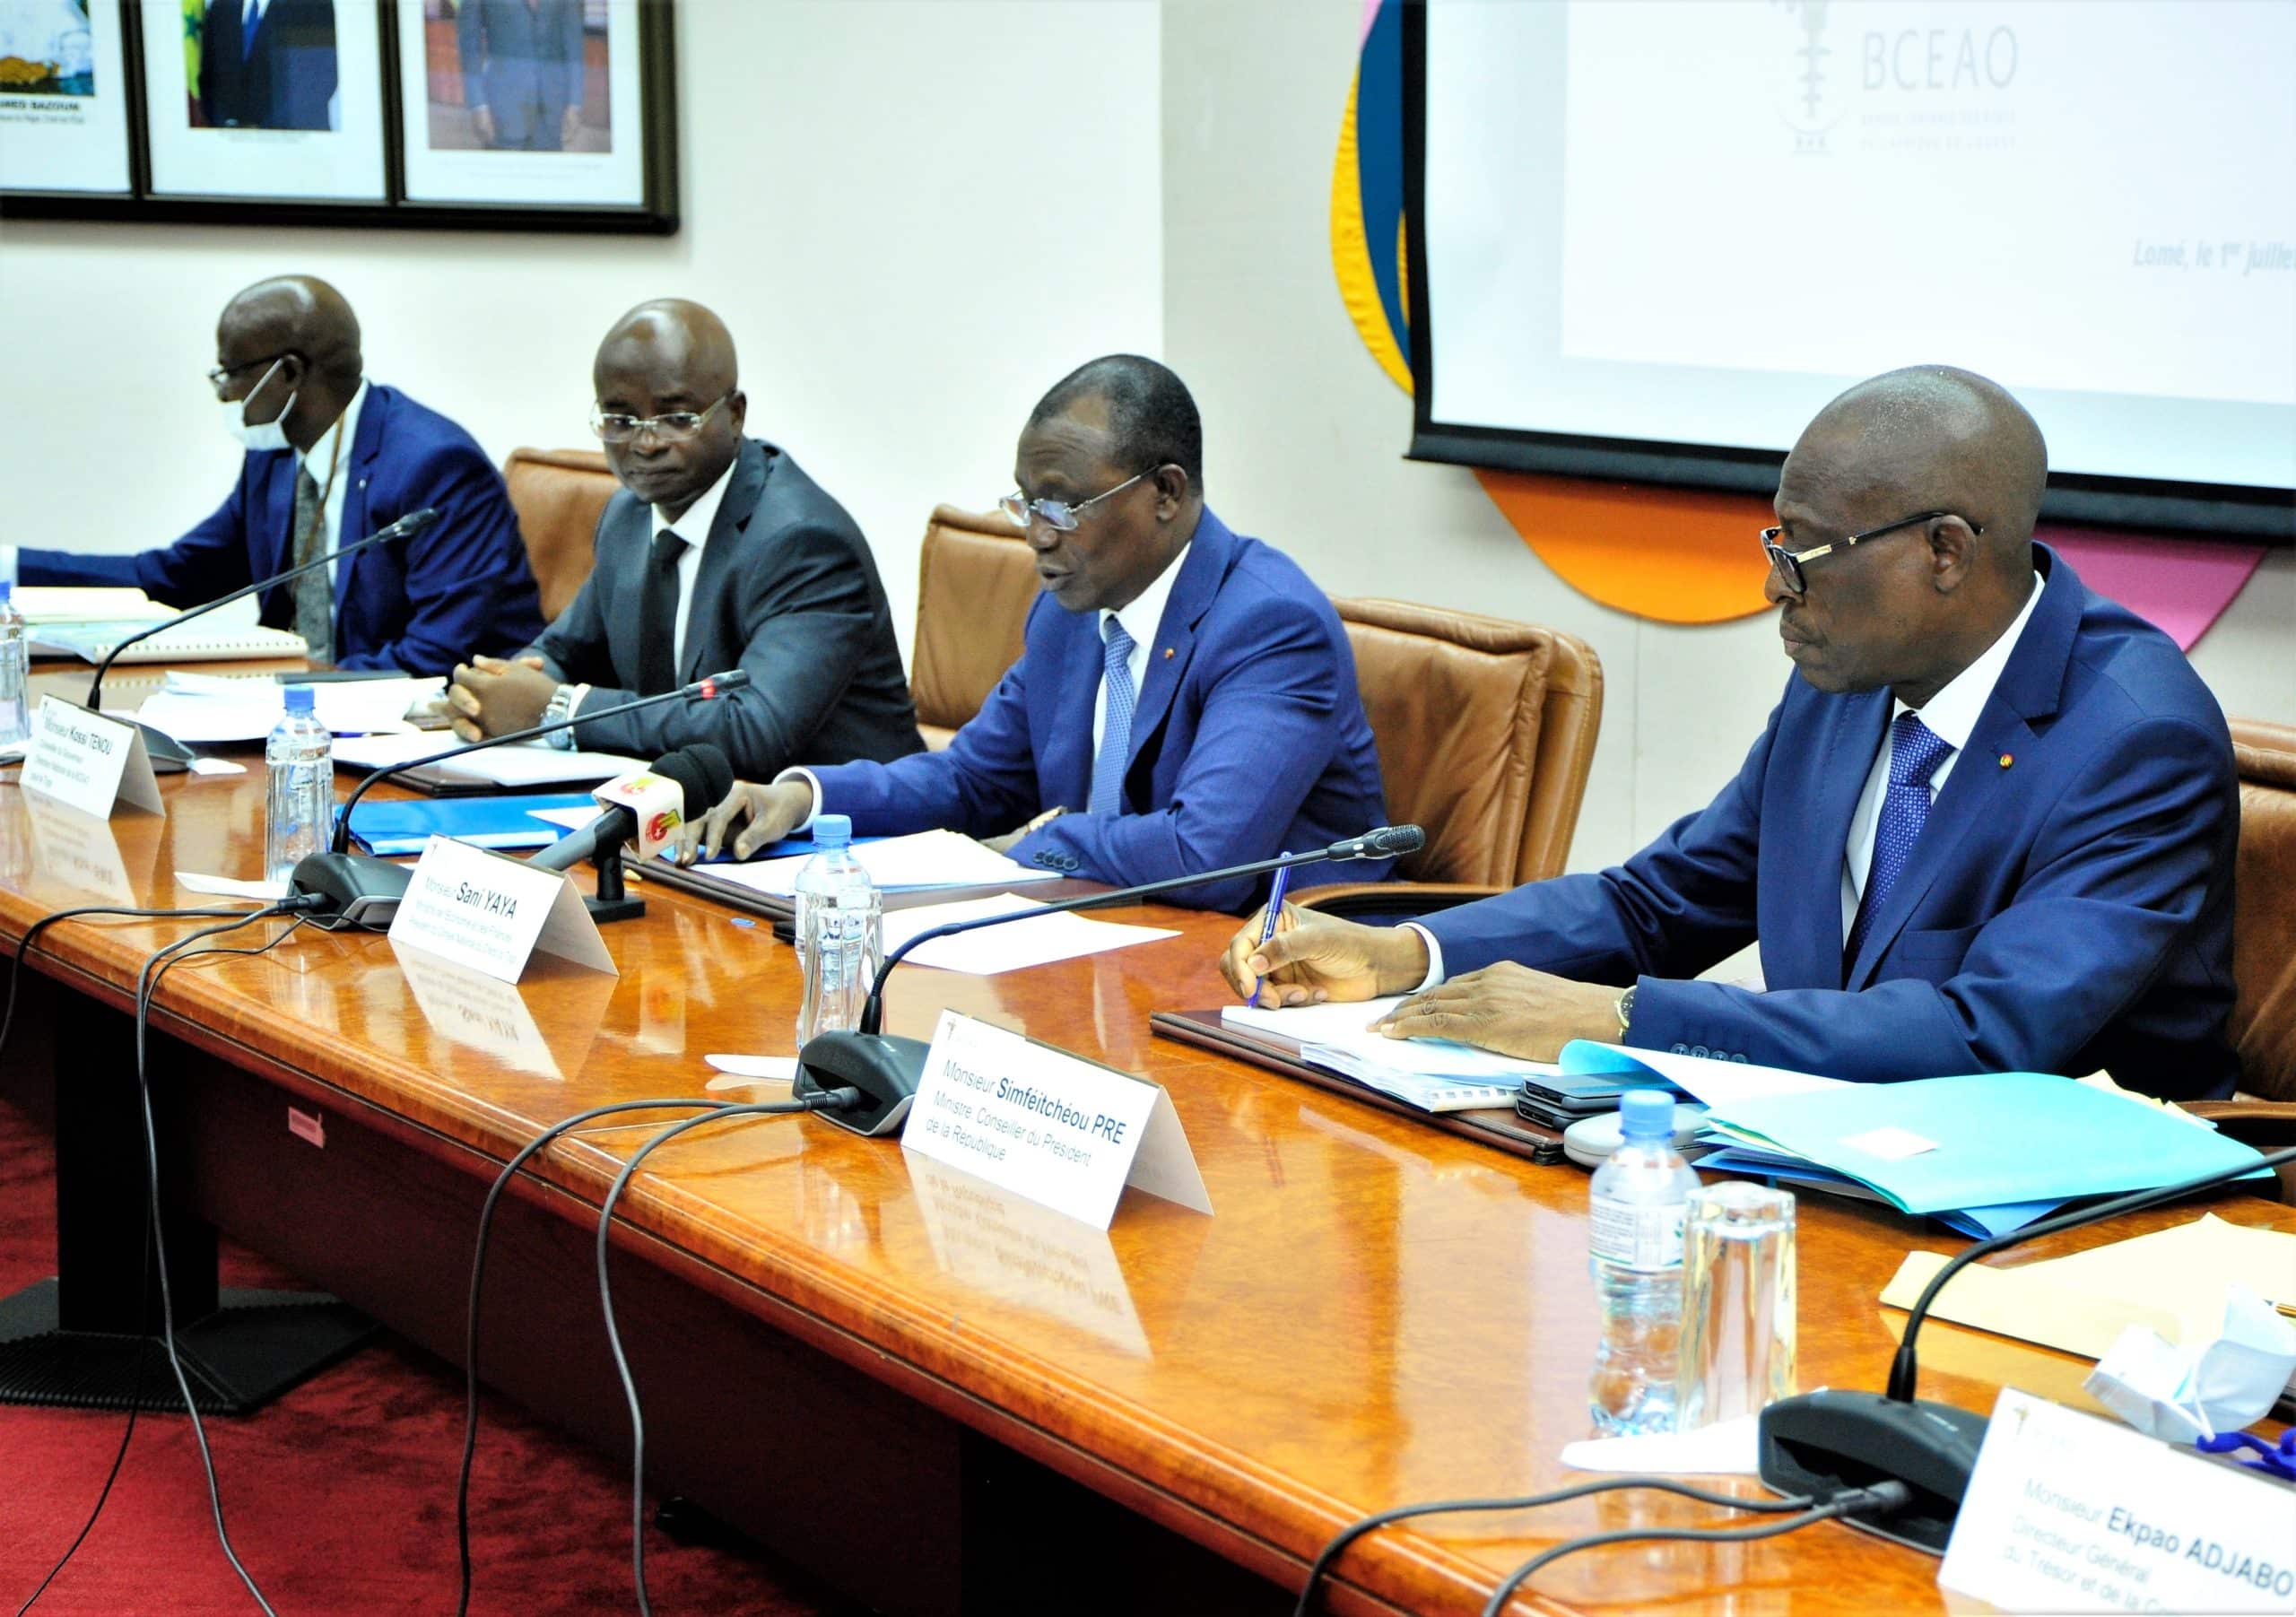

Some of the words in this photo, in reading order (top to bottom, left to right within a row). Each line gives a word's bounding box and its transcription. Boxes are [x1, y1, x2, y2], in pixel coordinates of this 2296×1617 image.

[1863, 24, 2019, 91] BCEAO
[2195, 238, 2213, 268] le
[2240, 239, 2296, 278] juille
[69, 726, 88, 746] Kossi
[457, 881, 485, 908] Sani
[483, 890, 517, 920] YAYA
[943, 1059, 996, 1094] Monsieur
[996, 1076, 1091, 1131] Simféitchéou
[1091, 1113, 1127, 1145] PRE
[926, 1116, 939, 1135] de
[940, 1118, 951, 1139] la
[952, 1124, 1006, 1161] République
[976, 1107, 1027, 1140] Conseiller
[1026, 1126, 1041, 1147] du
[2011, 1513, 2084, 1556] Directeur
[2085, 1543, 2152, 1586] Général
[2022, 1477, 2105, 1523] Monsieur
[2106, 1506, 2181, 1556] Ekpao
[2183, 1536, 2295, 1597] ADJABO
[2099, 1582, 2121, 1605] de
